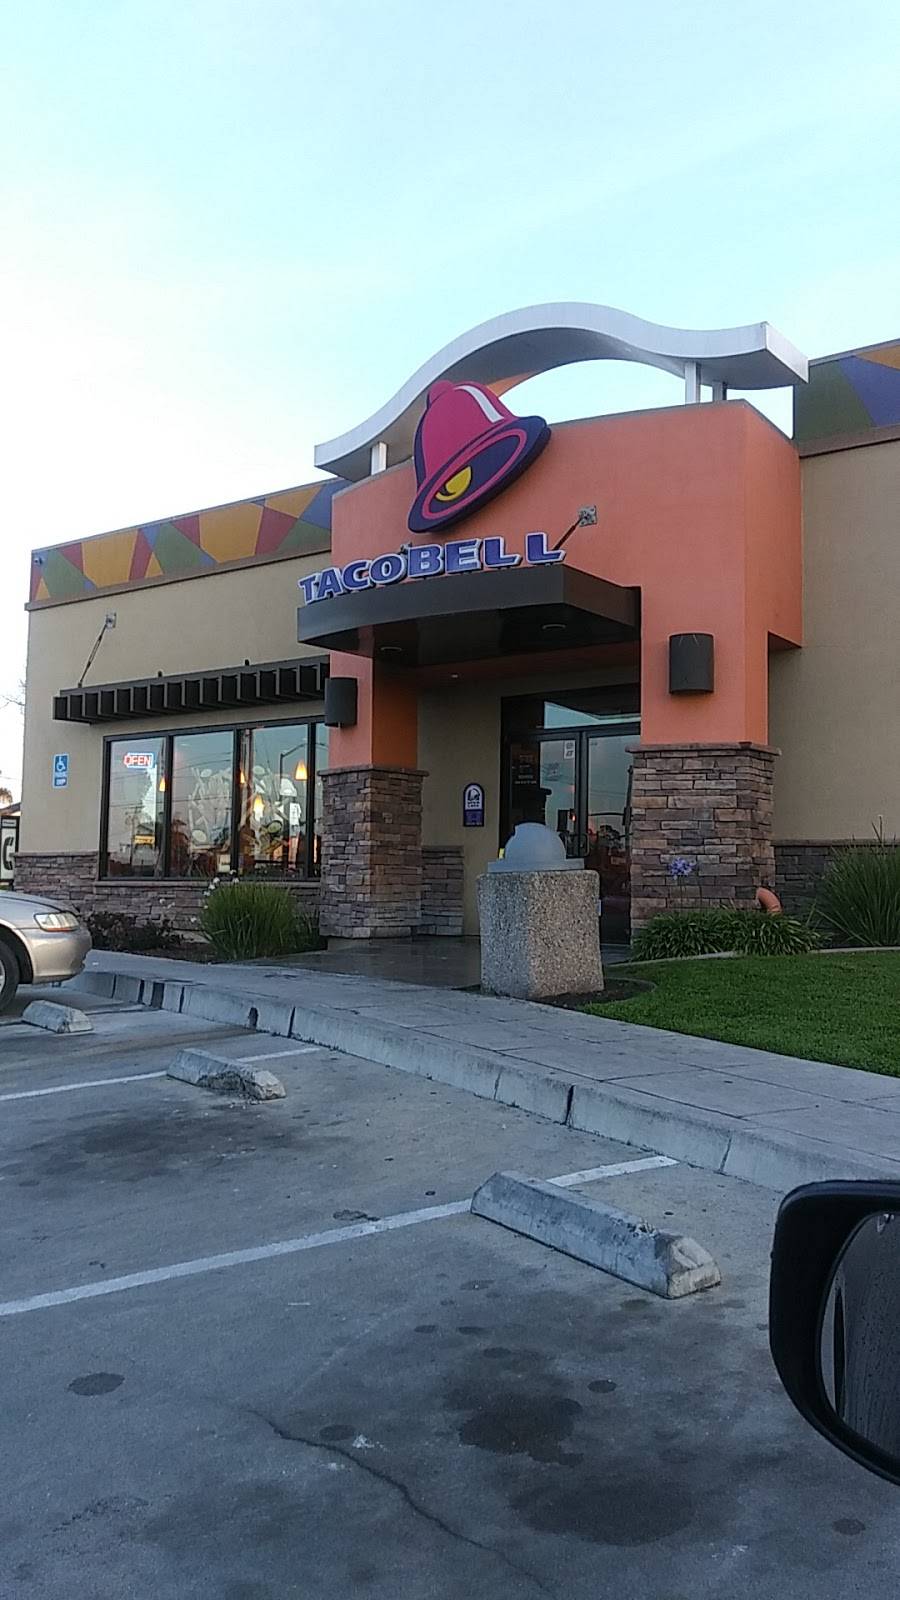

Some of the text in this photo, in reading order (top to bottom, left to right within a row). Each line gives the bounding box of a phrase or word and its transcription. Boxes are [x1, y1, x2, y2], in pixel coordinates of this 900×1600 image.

[298, 531, 567, 604] TACO BELL
[123, 754, 152, 767] OPEN
